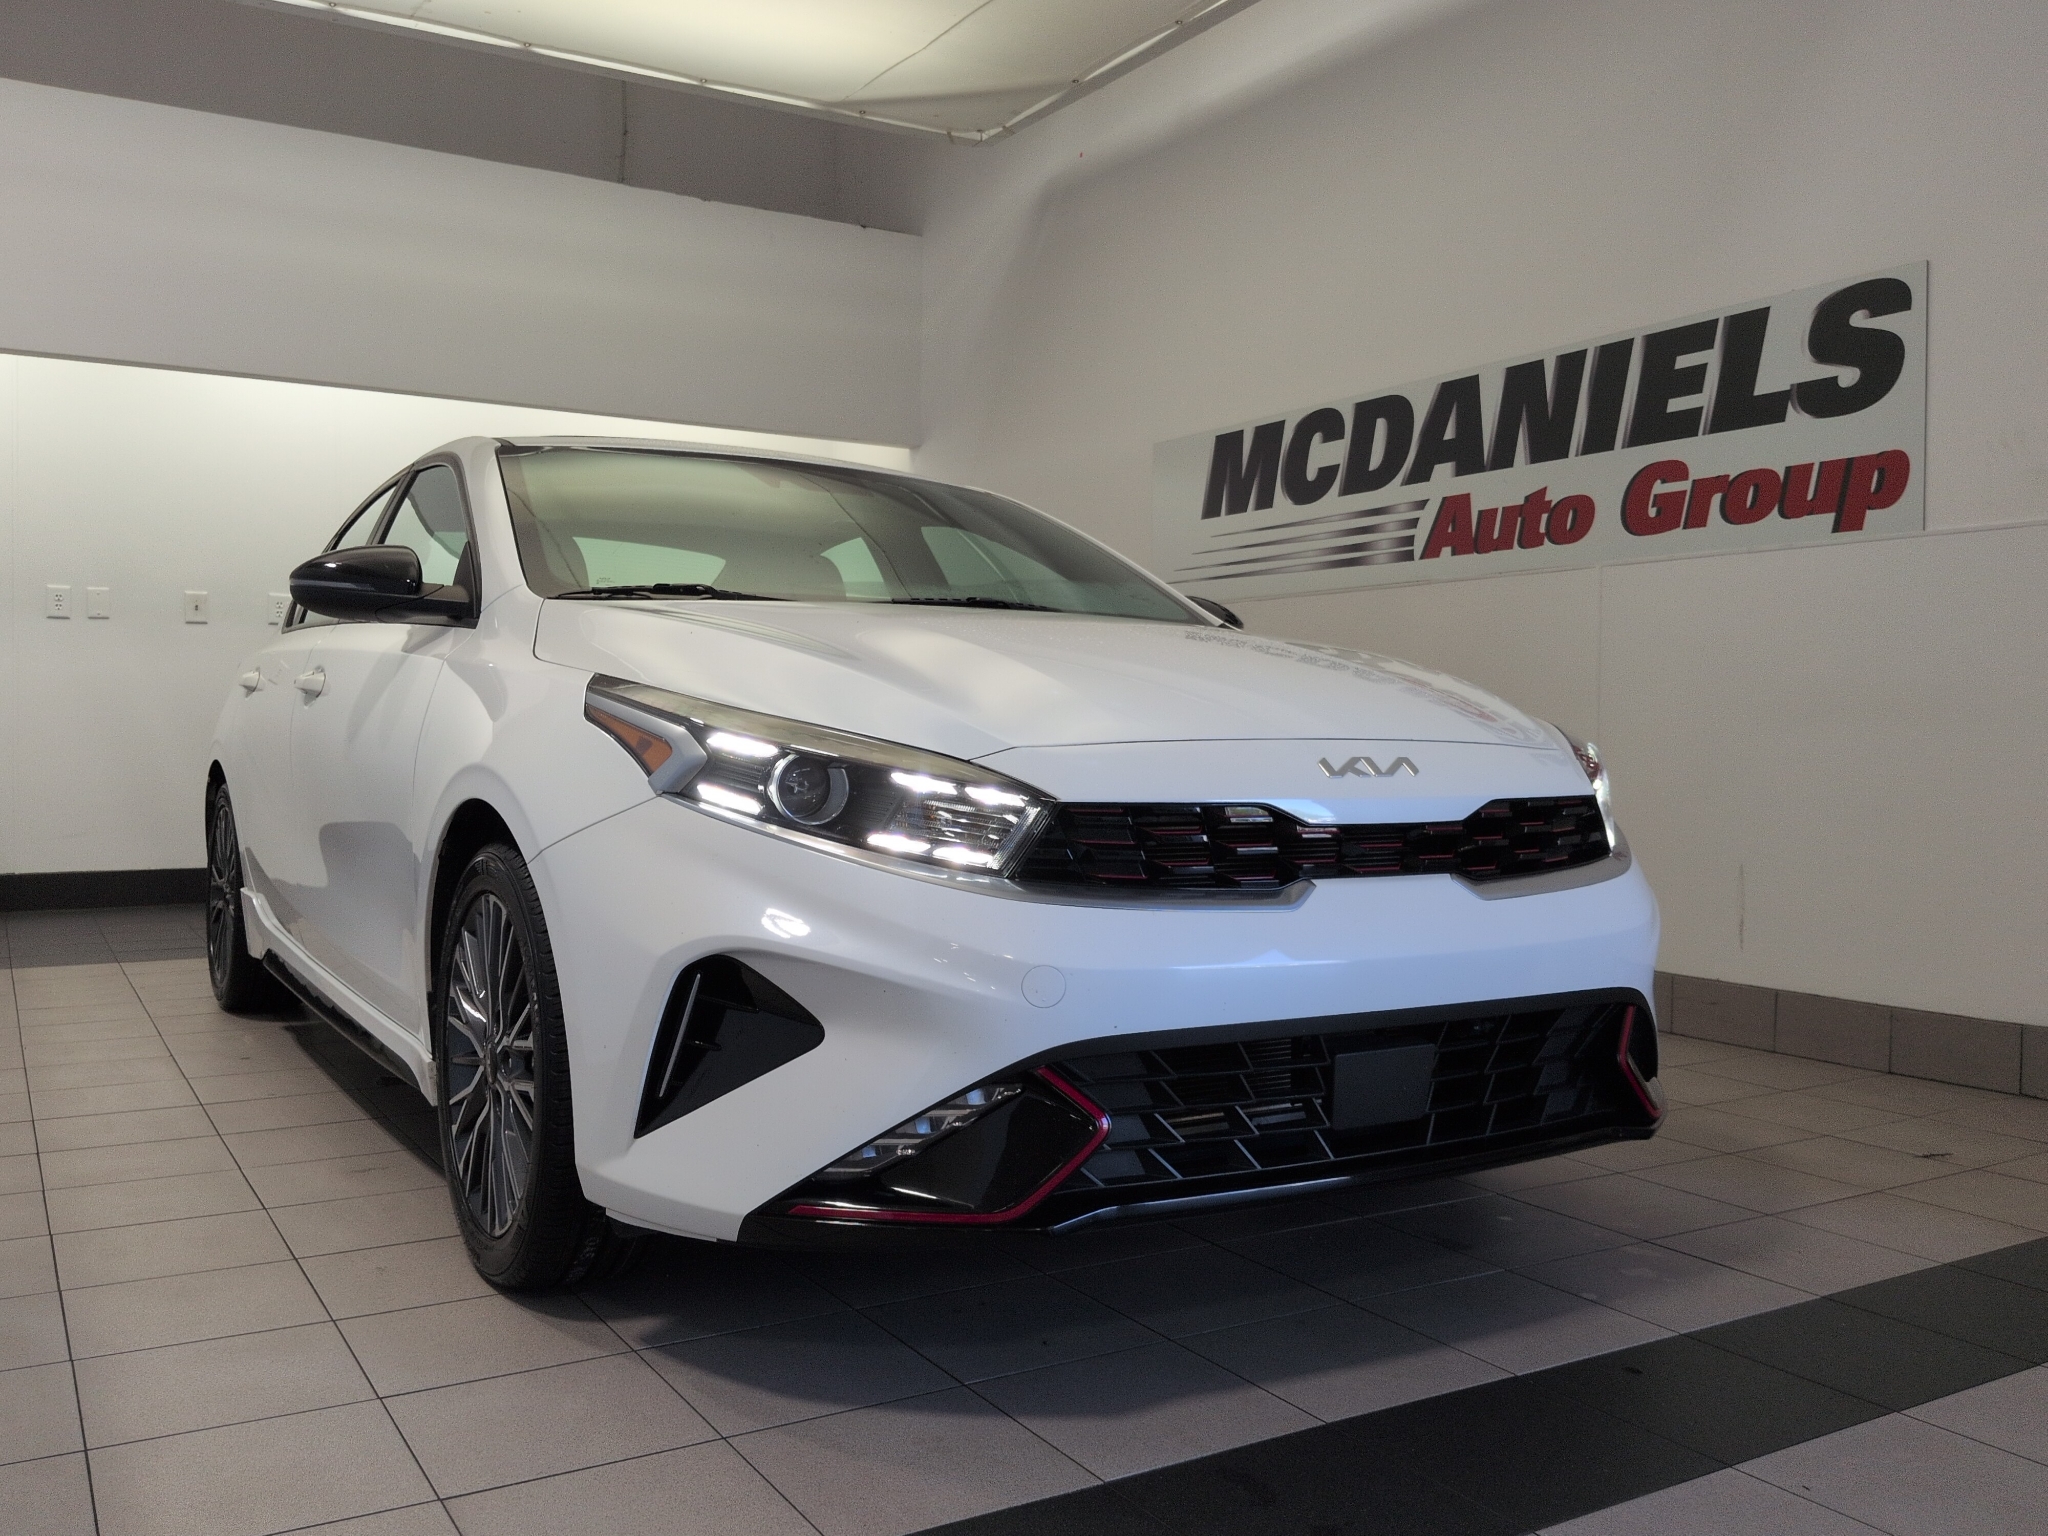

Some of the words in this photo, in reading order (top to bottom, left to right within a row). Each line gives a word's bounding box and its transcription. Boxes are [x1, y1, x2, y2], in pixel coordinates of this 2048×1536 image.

[1201, 277, 1912, 520] MCDANIELS
[1418, 486, 1596, 560] Auto
[1621, 449, 1910, 534] Group
[1317, 756, 1420, 778] KIA
